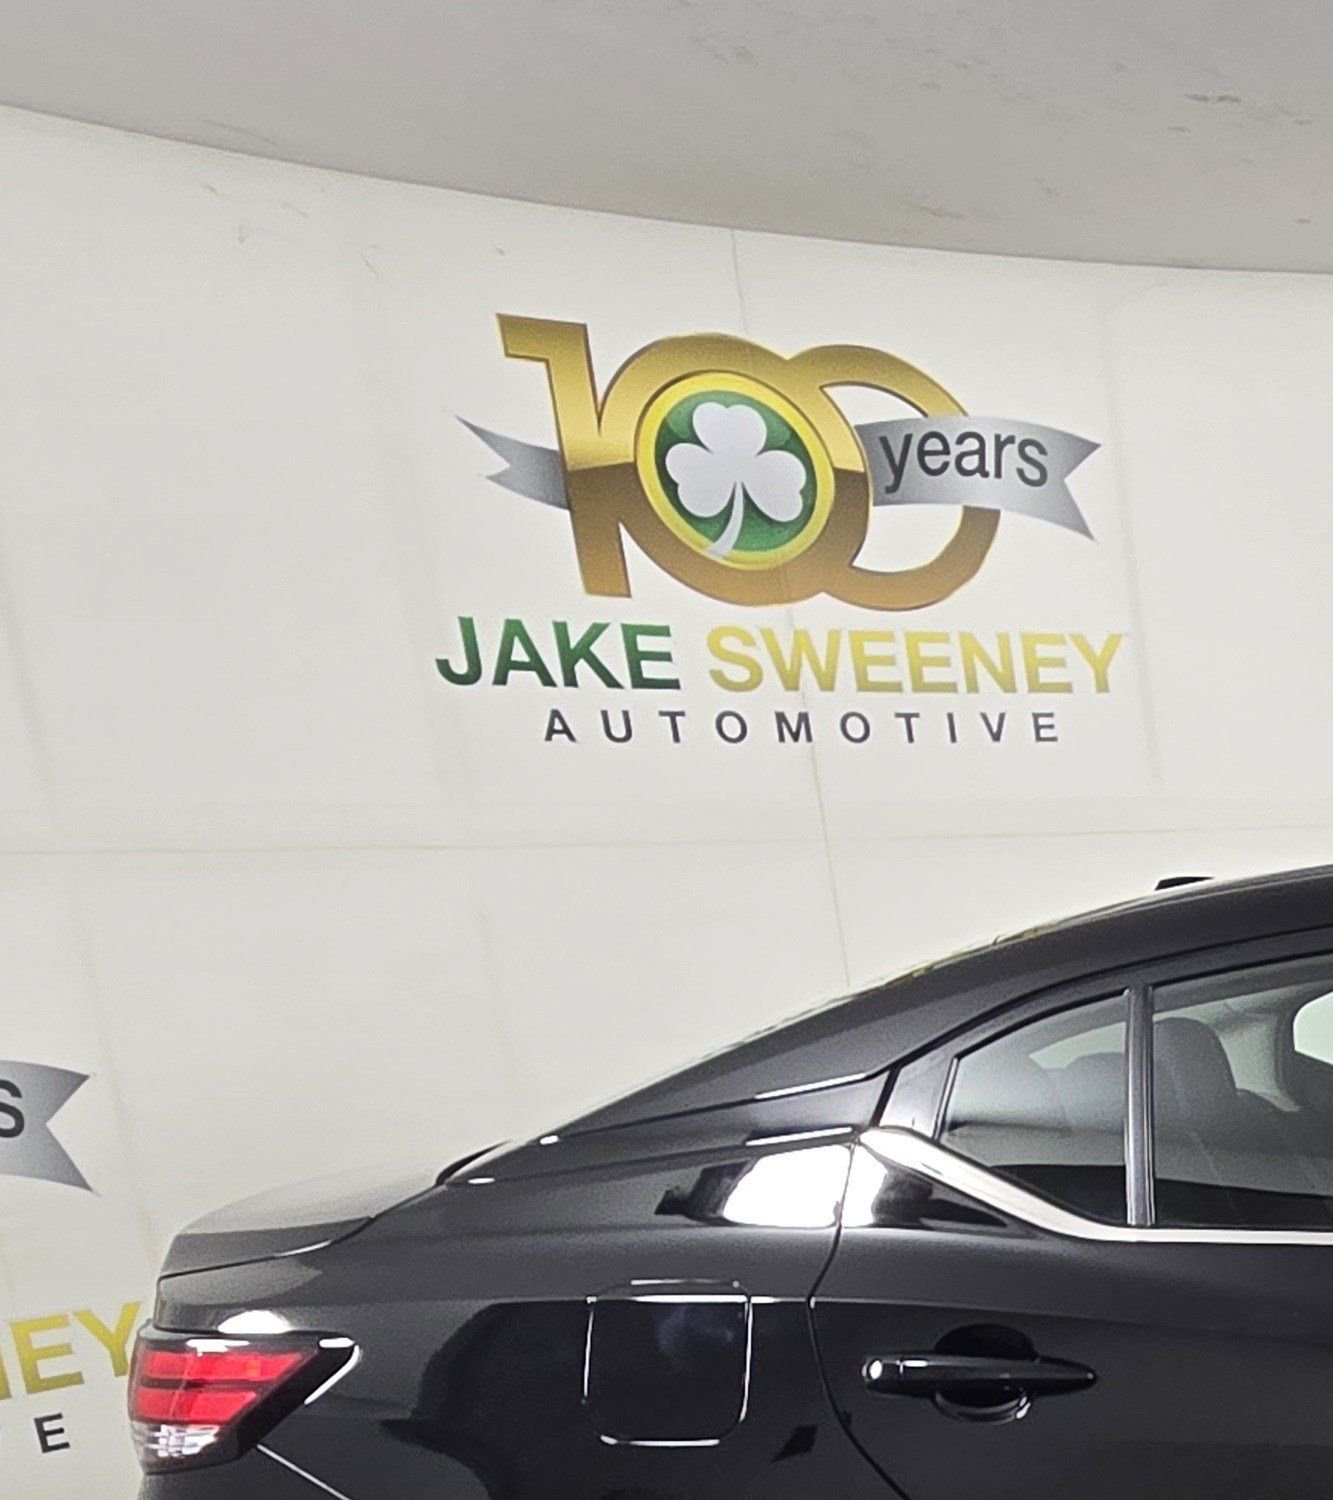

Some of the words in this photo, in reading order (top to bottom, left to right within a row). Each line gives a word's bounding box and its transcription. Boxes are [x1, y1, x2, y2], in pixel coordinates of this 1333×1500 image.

[496, 312, 1000, 612] 100
[878, 430, 1049, 495] years
[436, 616, 682, 691] JAKE
[707, 625, 1124, 694] SWEENEY
[544, 708, 1060, 745] AUTOMOTIVE
